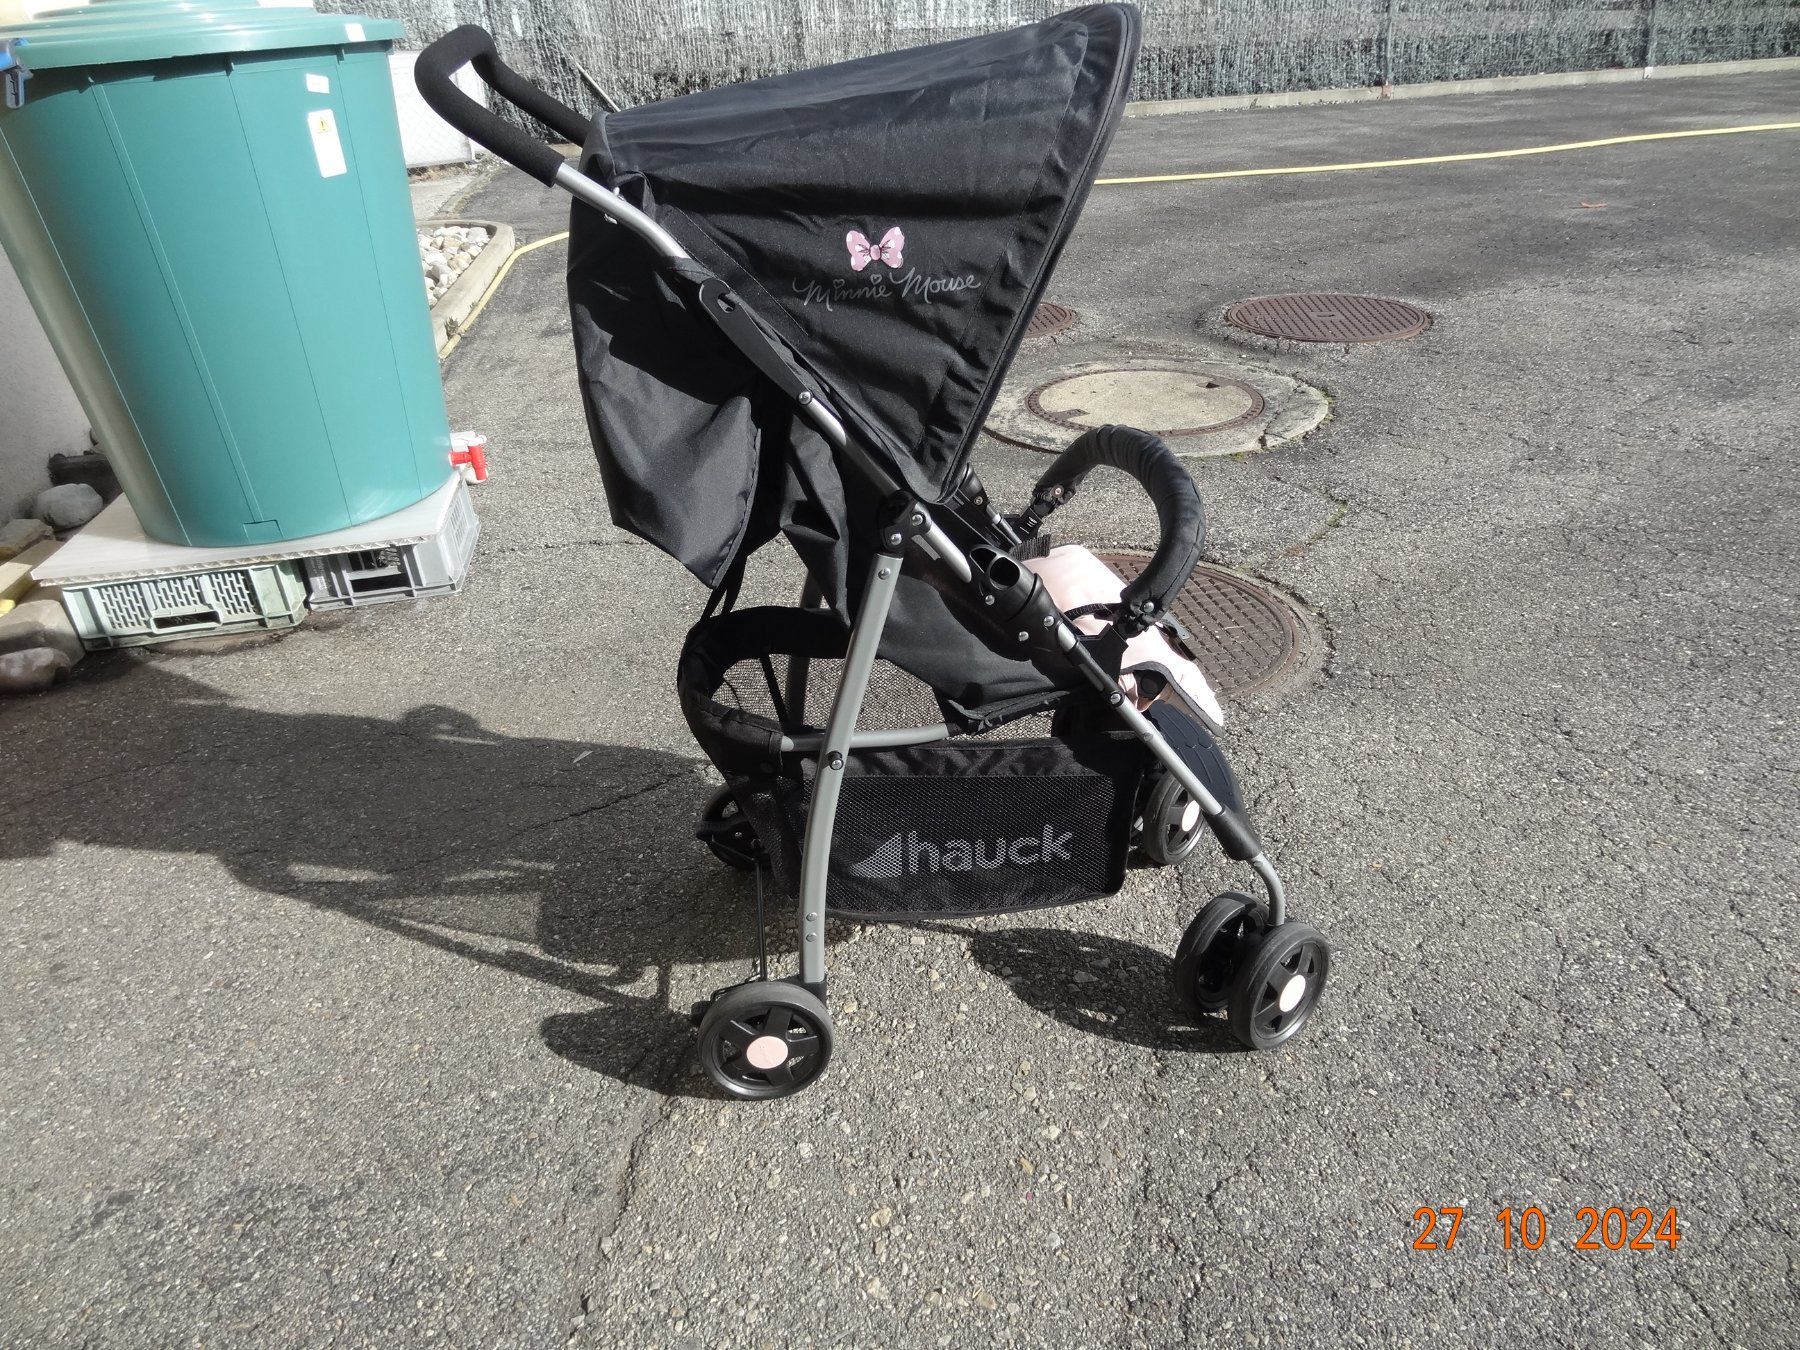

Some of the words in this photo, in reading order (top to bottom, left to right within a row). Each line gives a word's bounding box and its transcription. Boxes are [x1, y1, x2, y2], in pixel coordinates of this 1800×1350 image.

[792, 273, 892, 312] Minnie
[889, 267, 982, 305] Mouse
[907, 823, 1073, 875] hauck
